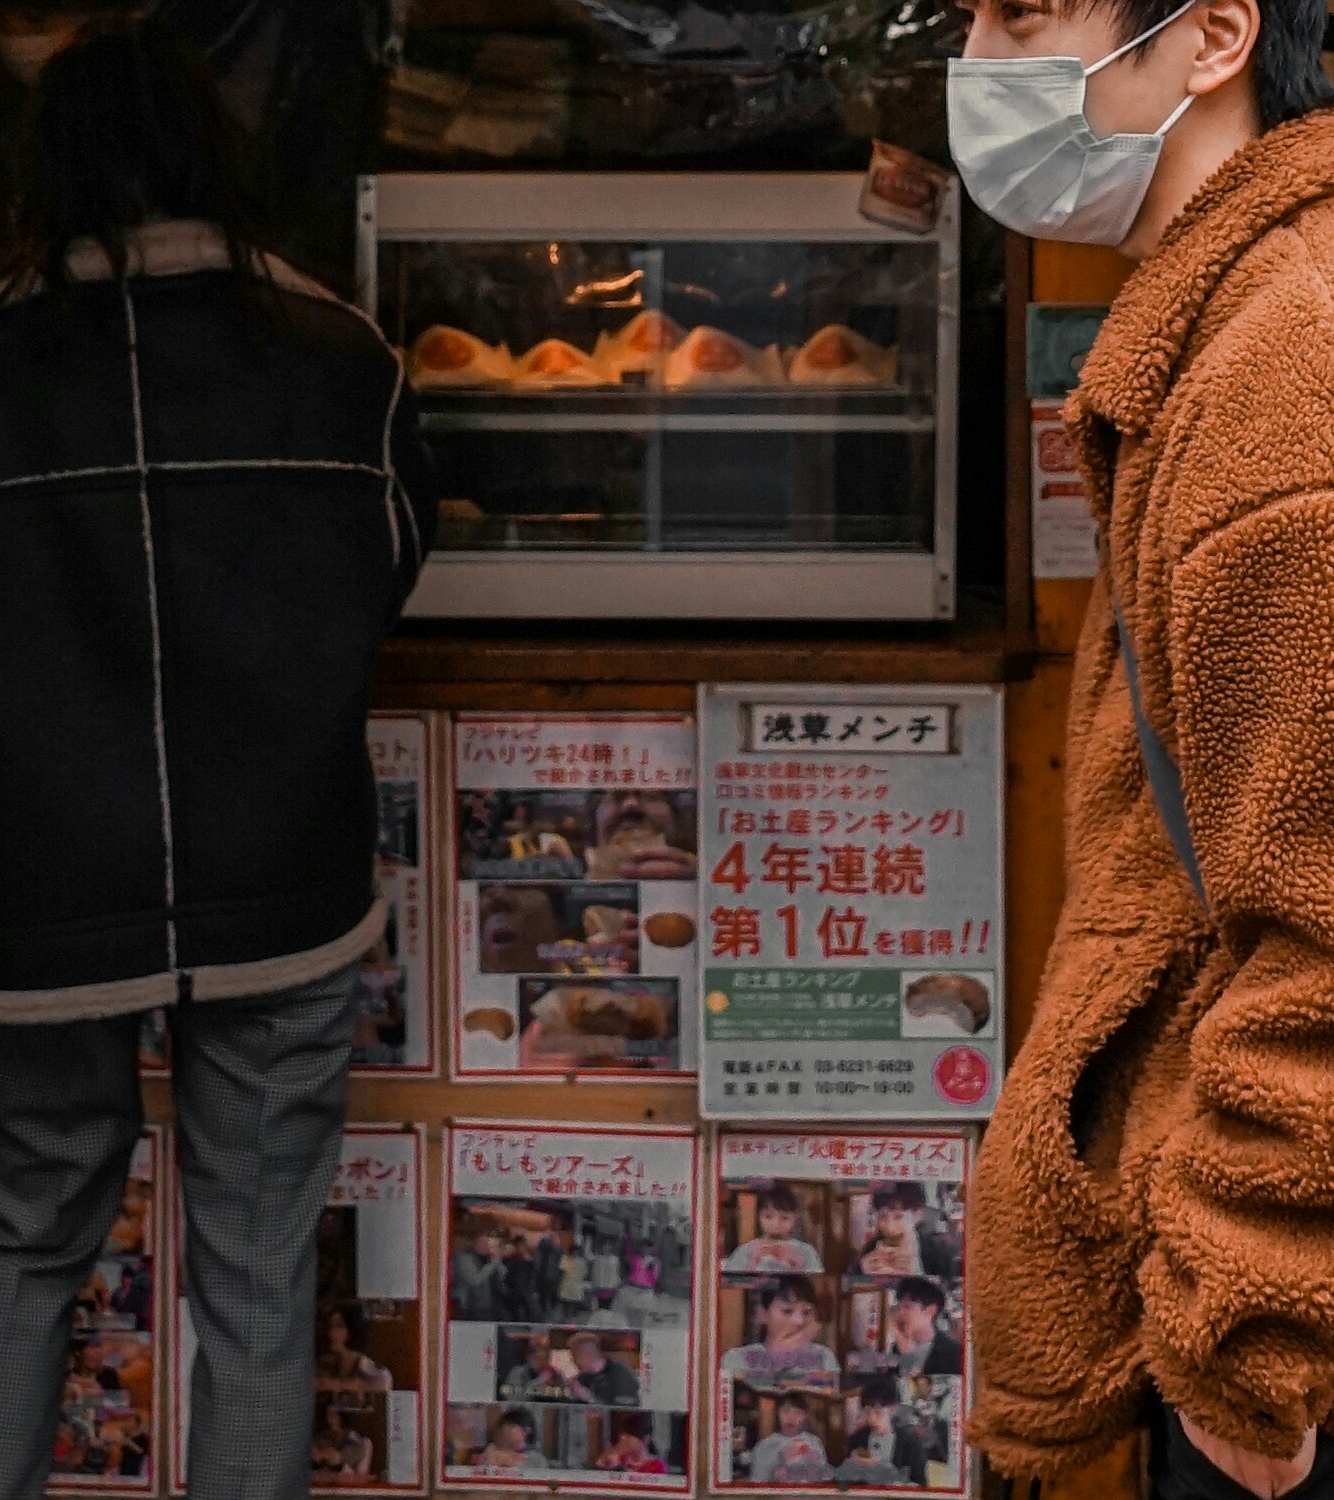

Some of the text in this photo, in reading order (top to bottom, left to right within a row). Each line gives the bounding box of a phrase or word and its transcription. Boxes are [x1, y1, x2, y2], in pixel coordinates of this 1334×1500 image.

[763, 713, 939, 744] 浅草メンチ
[711, 841, 927, 896] 4年連続
